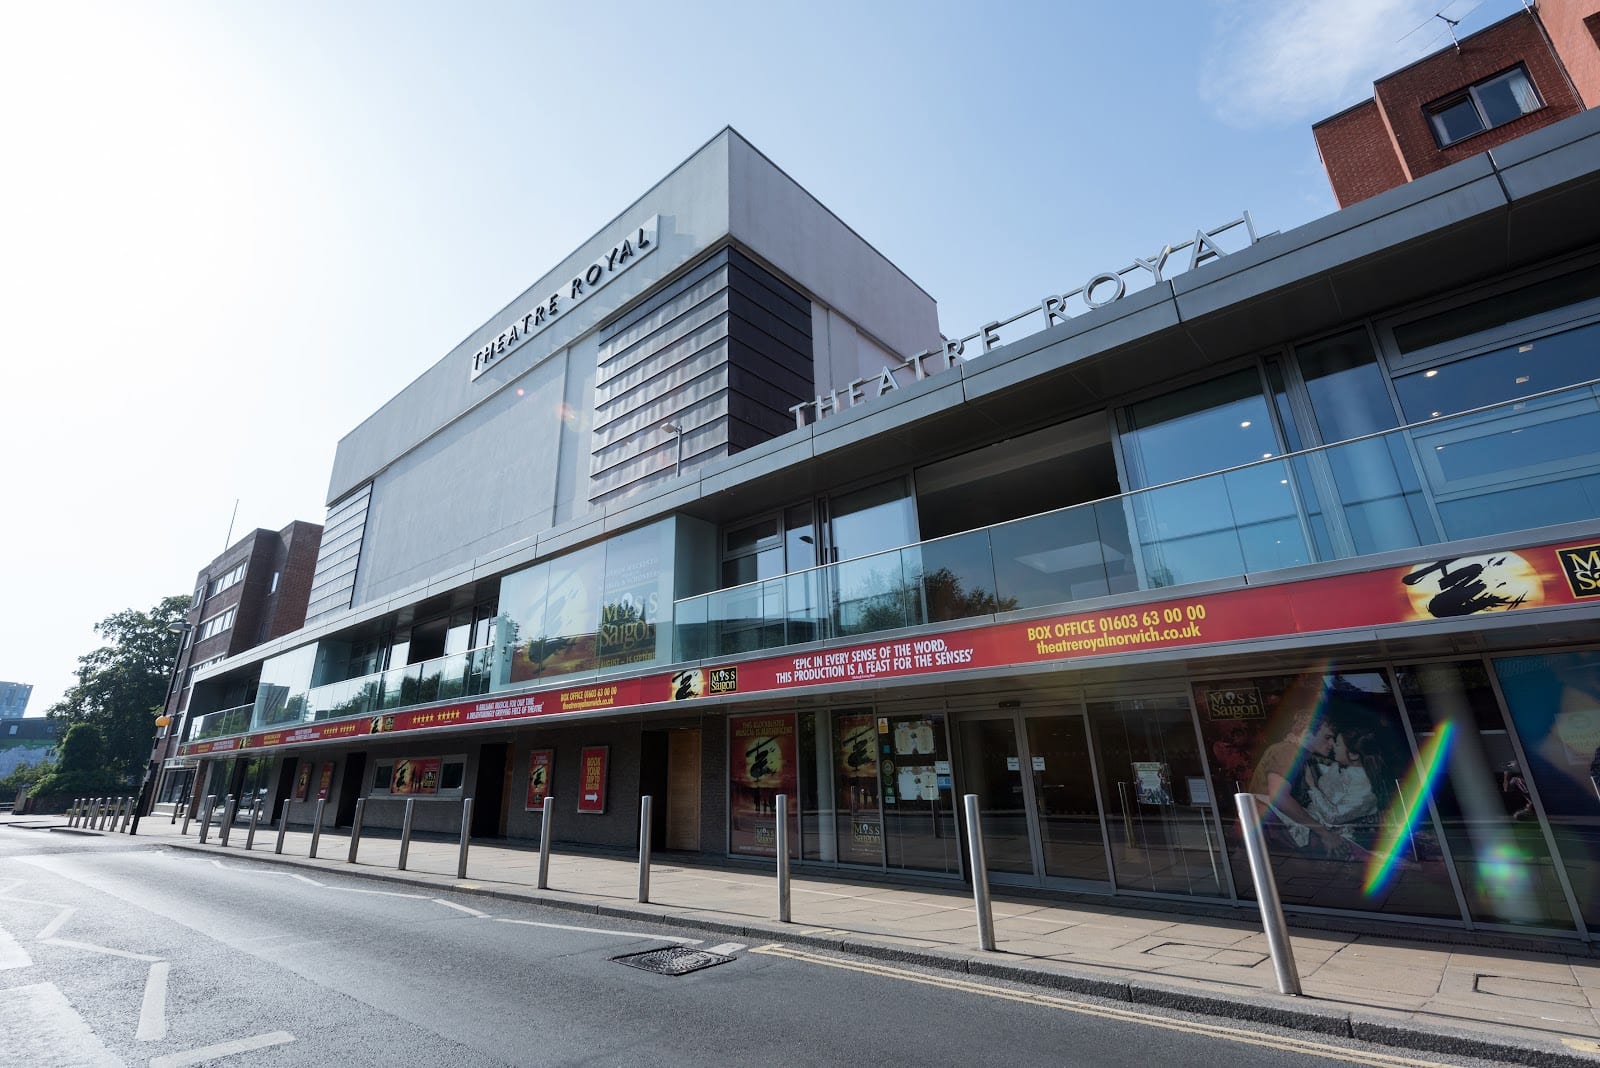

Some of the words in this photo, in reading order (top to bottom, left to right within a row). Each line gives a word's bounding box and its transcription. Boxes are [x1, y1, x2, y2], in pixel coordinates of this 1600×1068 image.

[473, 294, 559, 371] THEATRE
[571, 228, 650, 299] ROYAL
[788, 320, 1002, 429] THEATRE
[1041, 209, 1281, 329] ROYAL
[1027, 625, 1051, 641] BOX
[1055, 619, 1095, 638] OFFICE
[1099, 613, 1138, 631] 01603
[1142, 611, 1160, 626] 63
[1163, 607, 1182, 623] 00
[1186, 604, 1206, 620] 00
[1036, 621, 1201, 655] theatreroyalnorwich.co.uk
[776, 672, 792, 684] THIS
[793, 665, 845, 682] PRODUCTION
[847, 663, 855, 676] IS
[857, 662, 864, 675] A
[865, 658, 891, 674] FEAST
[893, 656, 912, 671] FOR
[915, 654, 933, 668] THE
[813, 655, 823, 668] IN
[825, 652, 850, 667] EVERY
[851, 648, 877, 664] SENSE
[879, 646, 891, 659] OF
[893, 643, 911, 657] THE
[913, 639, 948, 654] WORD,
[711, 680, 736, 692] Saigon
[1211, 702, 1261, 718] Saigon
